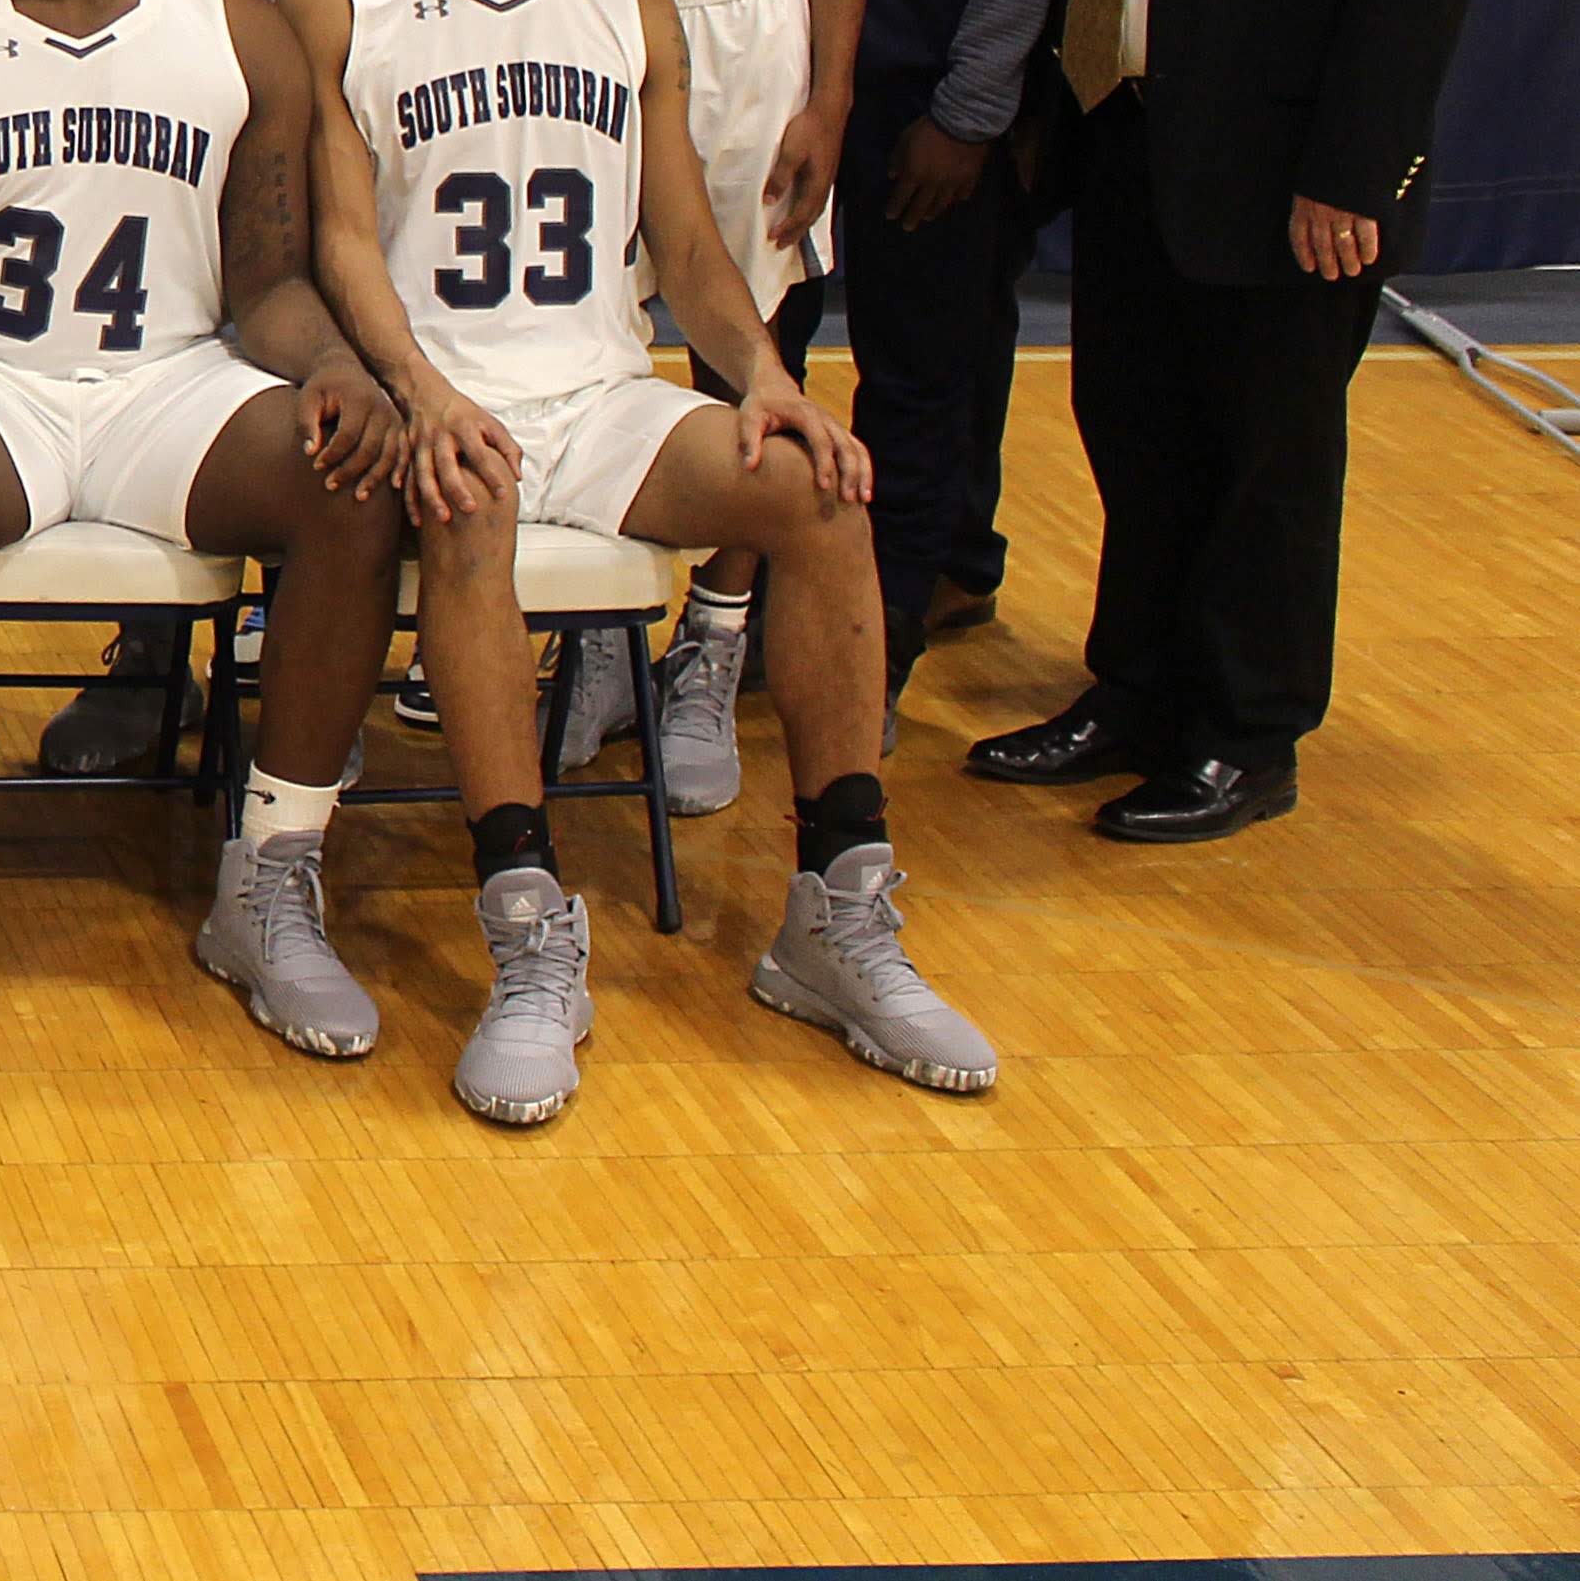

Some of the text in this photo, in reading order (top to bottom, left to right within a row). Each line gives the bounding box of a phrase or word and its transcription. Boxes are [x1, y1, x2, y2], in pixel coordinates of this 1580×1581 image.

[62, 107, 211, 188] SUBURBAN
[397, 61, 629, 151] SOUTH SUBURBAN
[434, 168, 594, 310] 33
